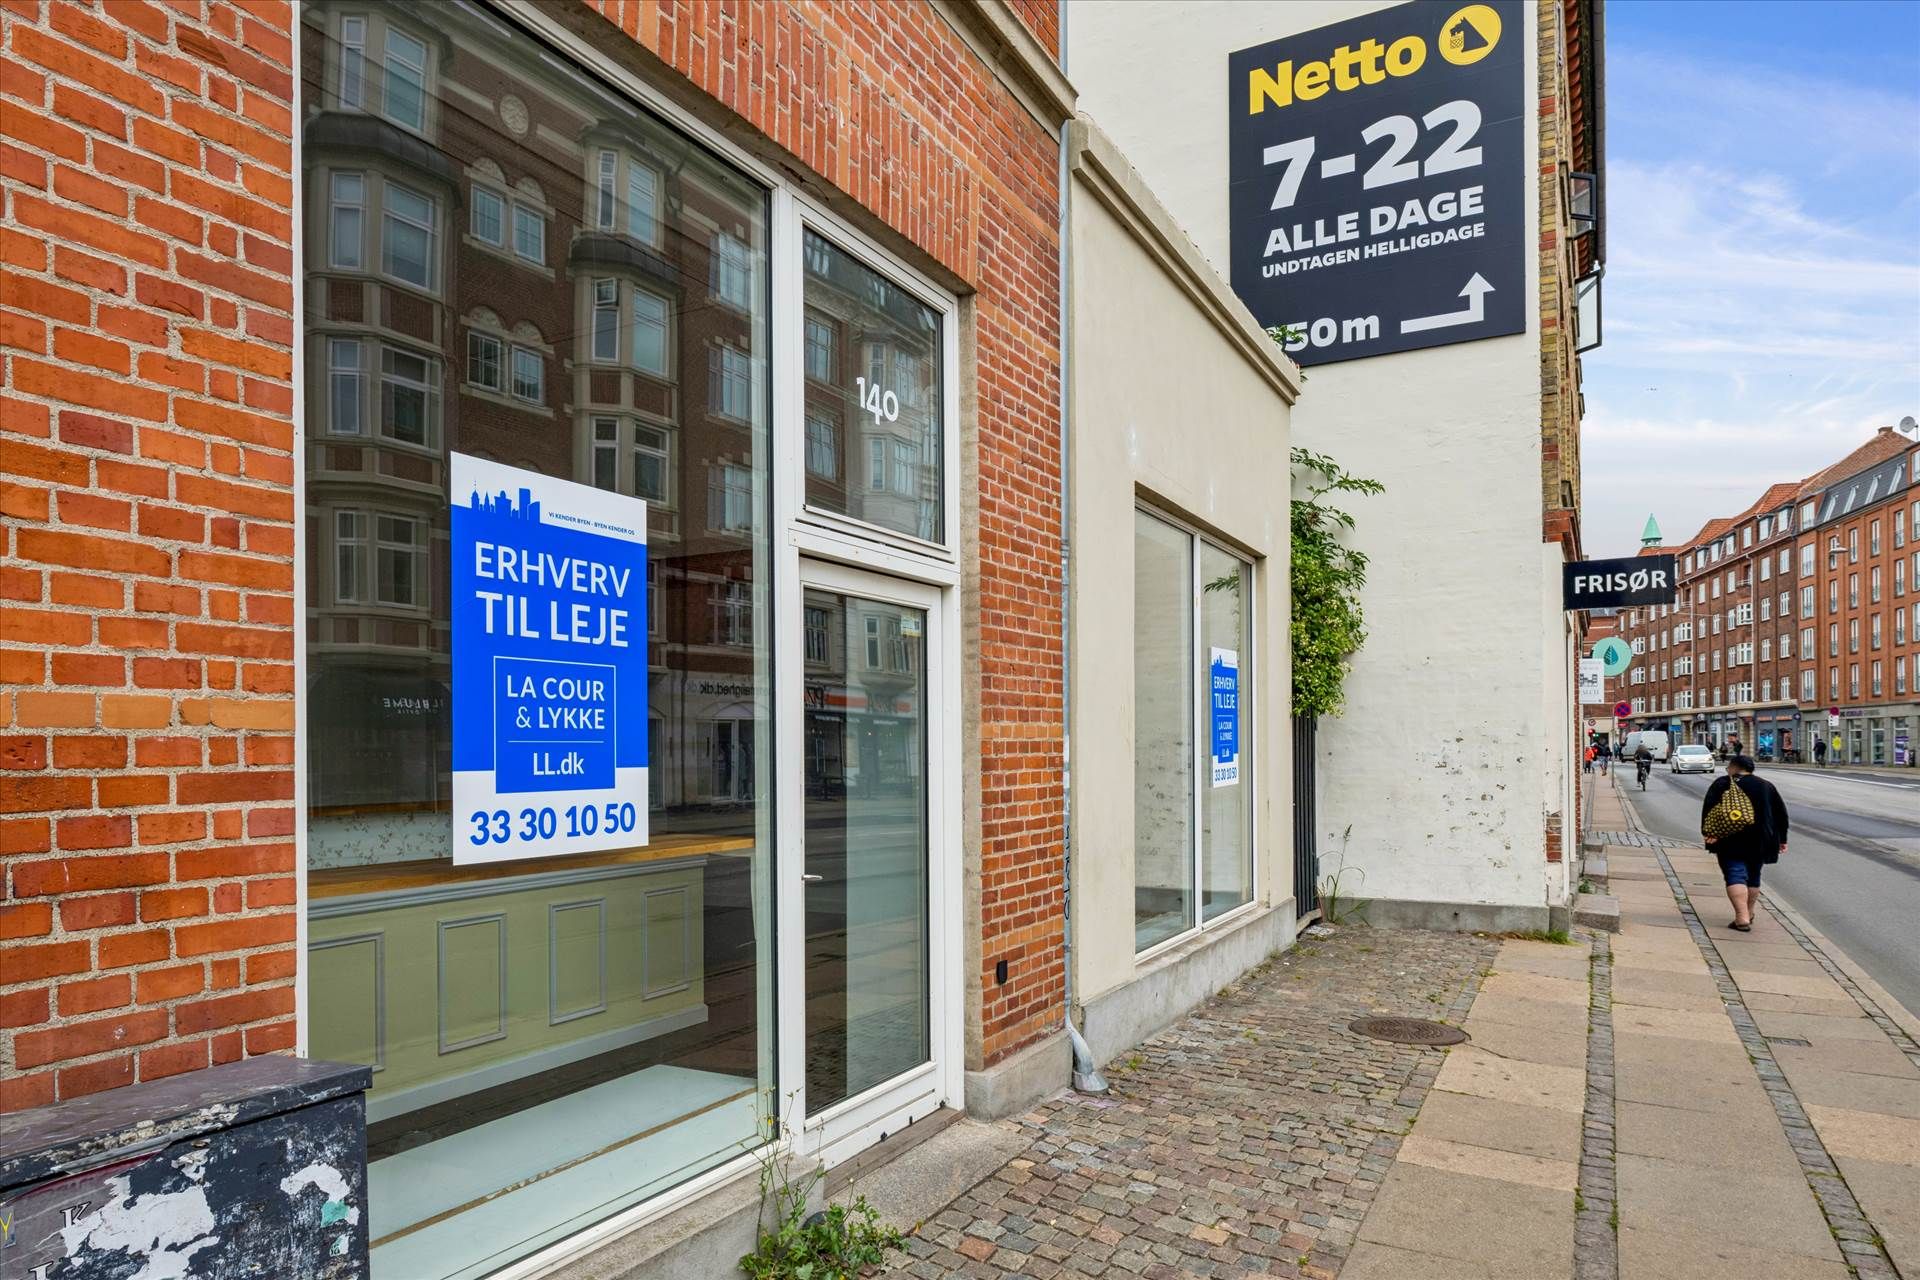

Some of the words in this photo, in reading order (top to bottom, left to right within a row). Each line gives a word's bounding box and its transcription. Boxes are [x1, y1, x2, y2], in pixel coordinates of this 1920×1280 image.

[1249, 35, 1427, 115] Netto
[1263, 100, 1483, 211] 7-22
[1263, 212, 1359, 258] ALLE
[1370, 185, 1484, 236] DAGE
[1262, 248, 1360, 279] UNDTAGEN
[1363, 222, 1485, 258] HELLIGDAGE
[856, 376, 899, 426] 140
[555, 513, 577, 524] KENDER
[577, 518, 591, 526] BYEN
[594, 521, 608, 530] BYEN
[608, 523, 628, 535] KENDER
[475, 541, 631, 598] ERHVERV
[1574, 568, 1667, 594] FRISØR
[475, 590, 540, 639] TIL
[550, 600, 628, 648] LEJE
[507, 675, 537, 698] LA
[543, 677, 605, 702] COUR
[1214, 676, 1235, 690] ERHVERV
[1214, 693, 1223, 708] TIL
[1223, 694, 1235, 708] LEJE
[515, 706, 532, 728] &
[538, 706, 605, 730] LYKKE
[533, 752, 584, 776] LL.dk
[470, 811, 511, 846] 33
[519, 807, 557, 841] 30
[565, 804, 598, 837] 10
[604, 802, 636, 834] 50
